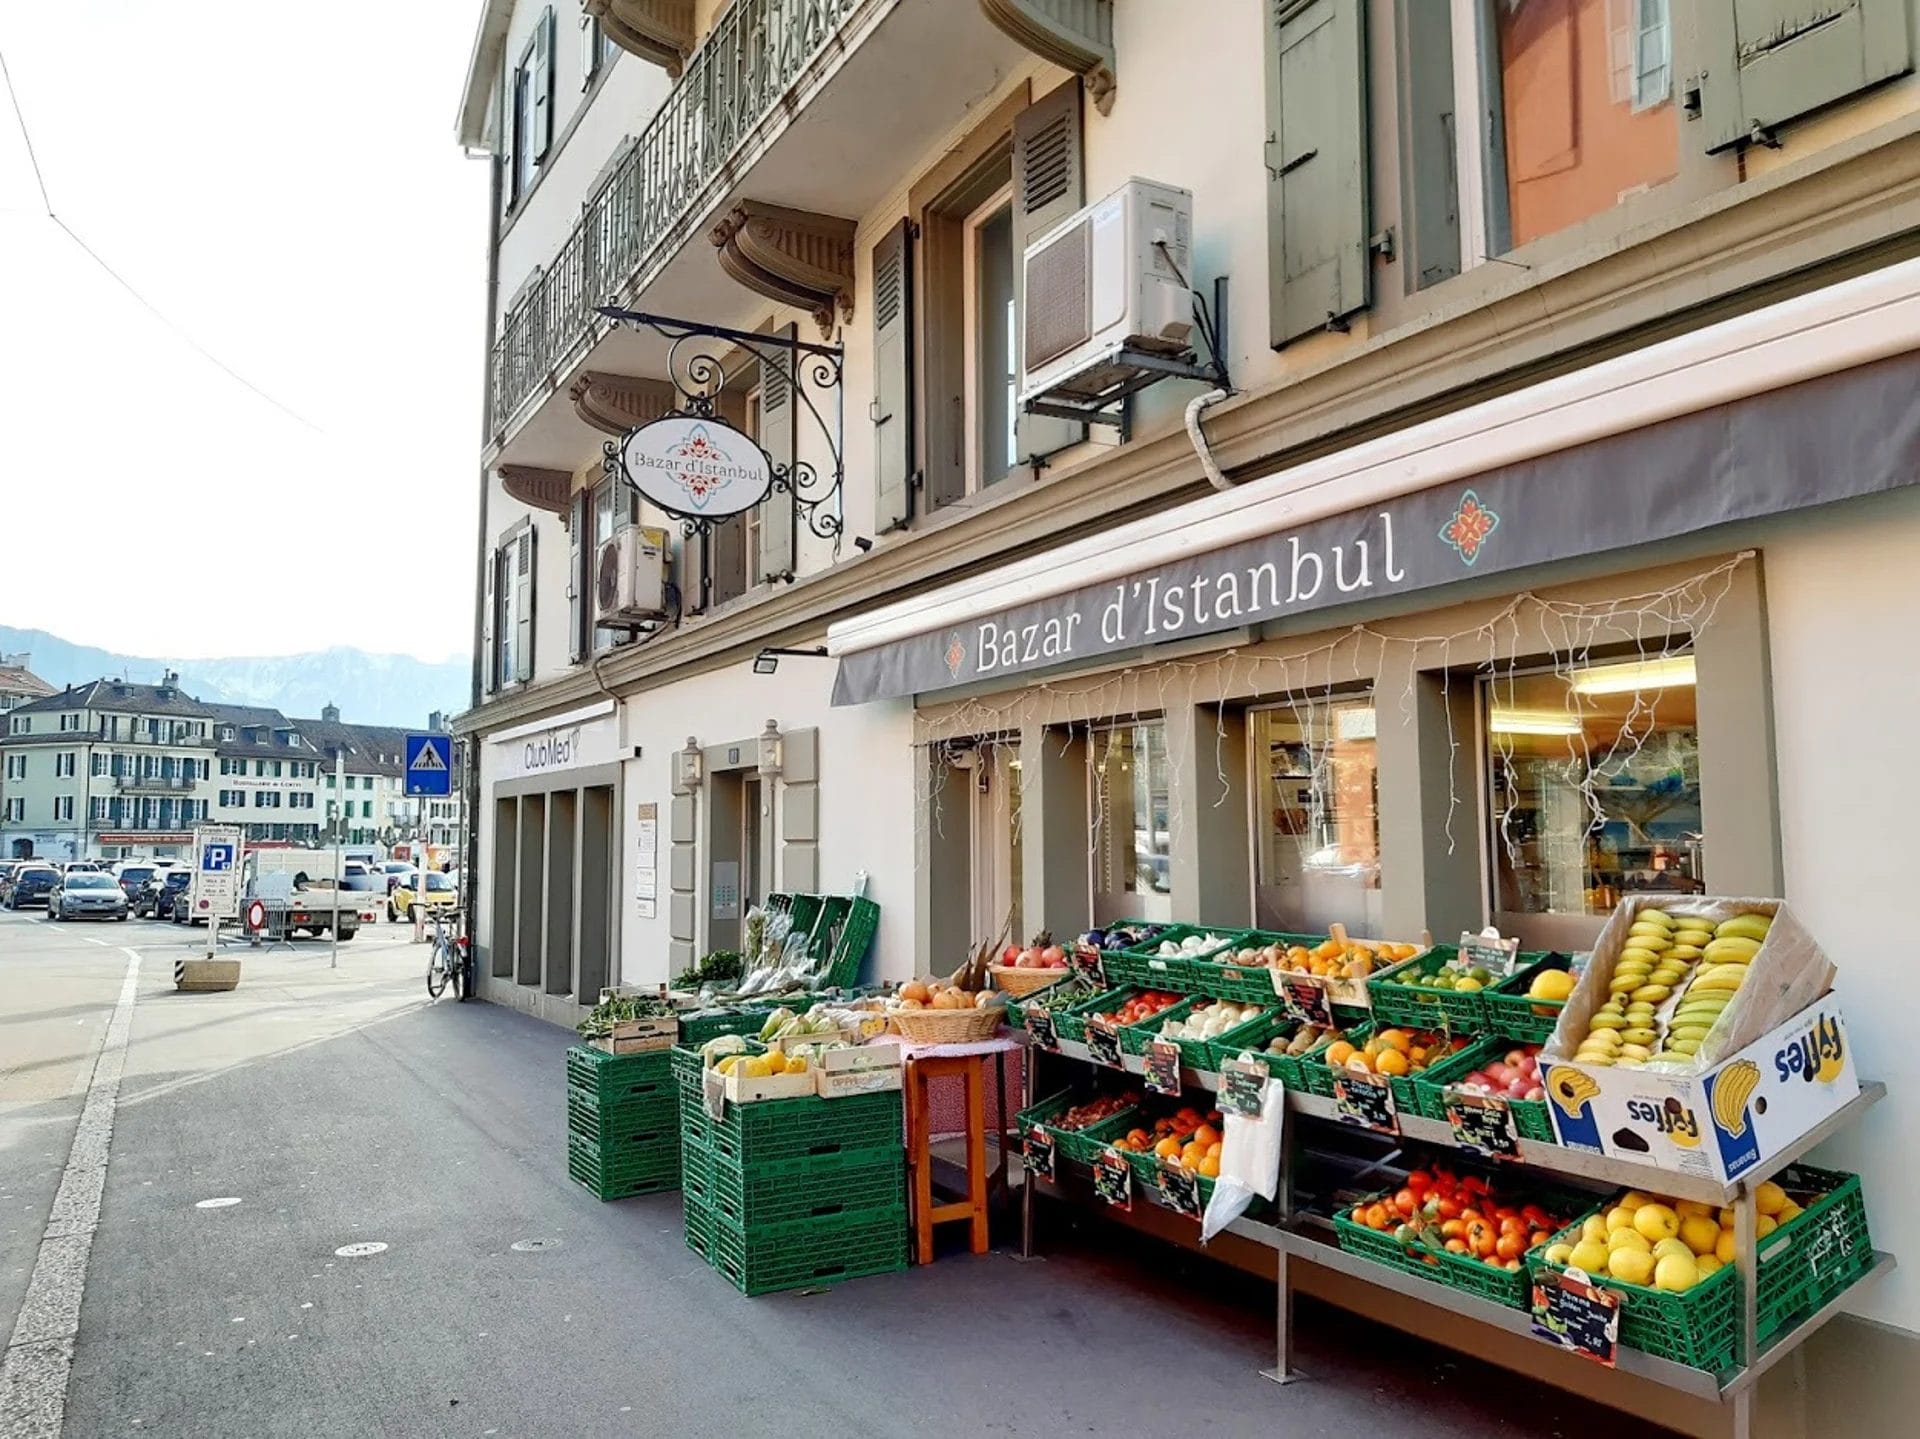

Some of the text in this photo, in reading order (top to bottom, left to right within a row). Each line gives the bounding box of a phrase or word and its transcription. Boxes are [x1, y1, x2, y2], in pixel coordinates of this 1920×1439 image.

[634, 452, 764, 481] Bazar d'Istanbul
[976, 512, 1406, 674] Bazar d'Istanbul
[210, 847, 226, 868] P
